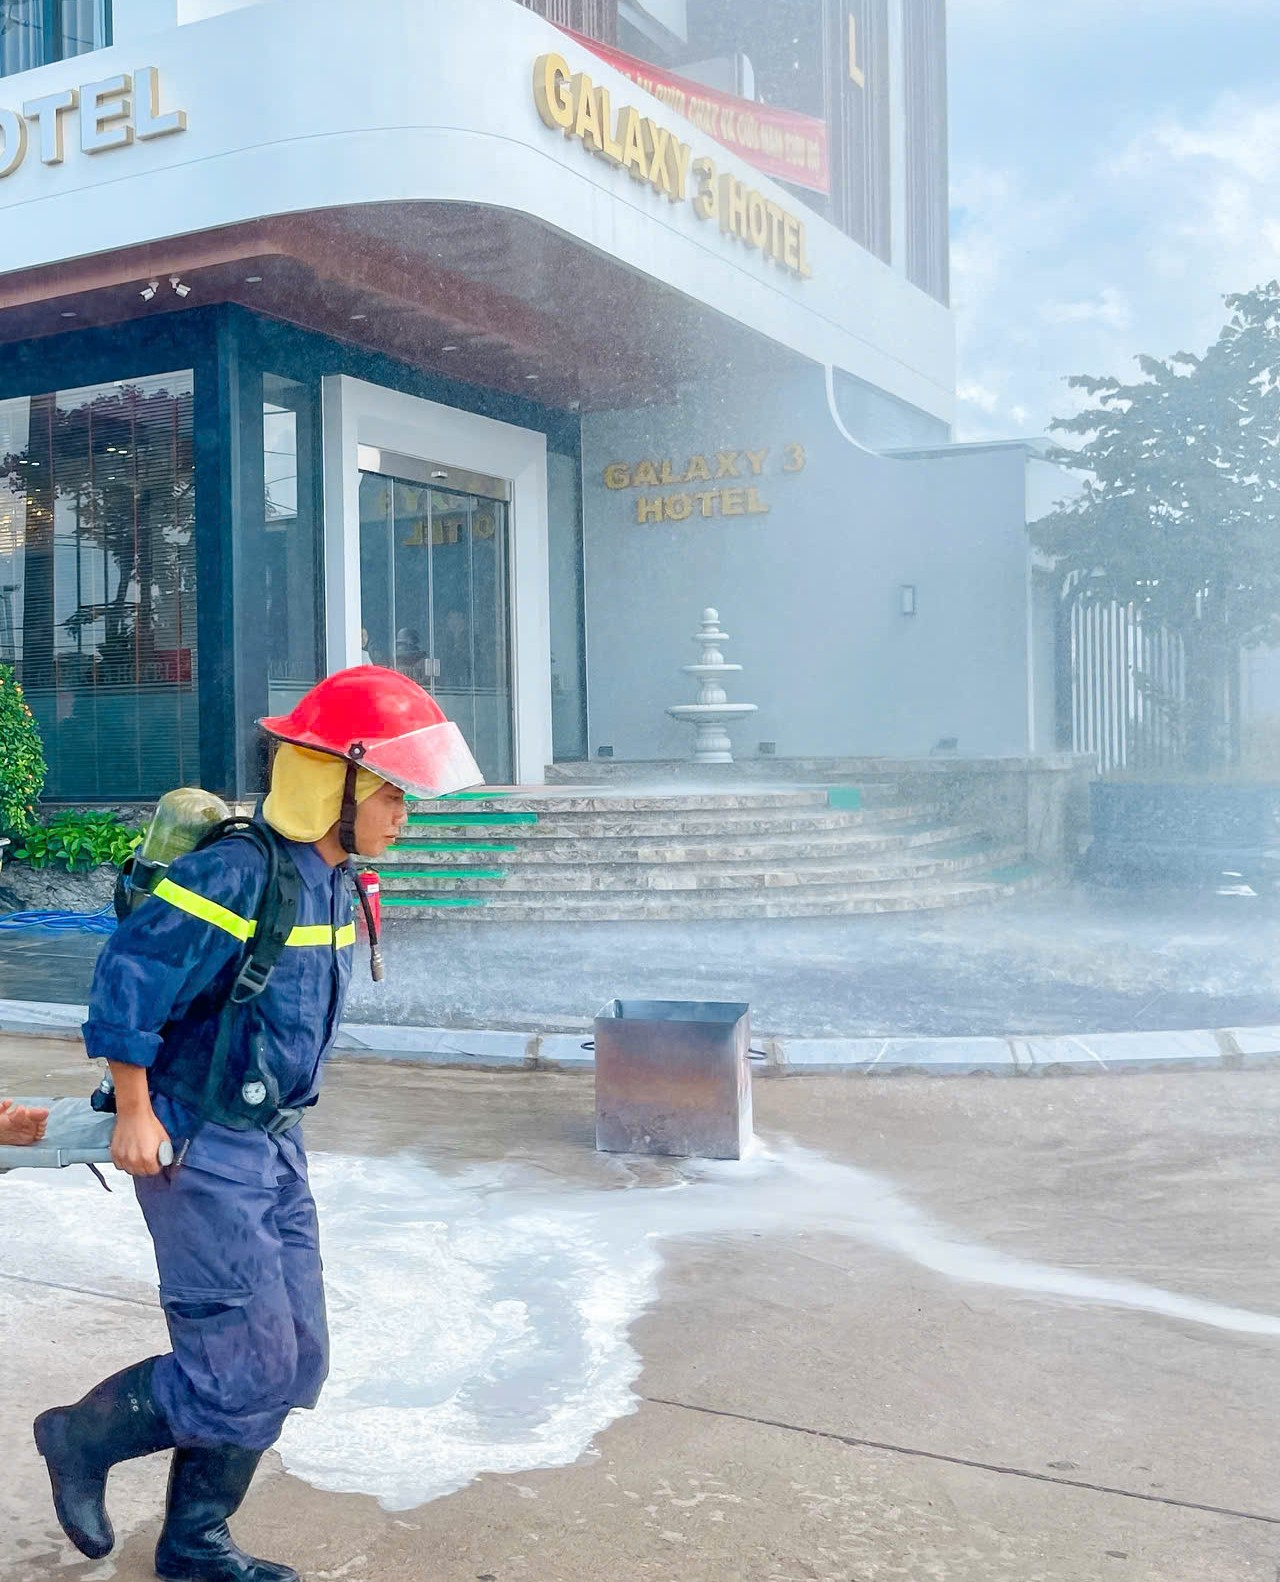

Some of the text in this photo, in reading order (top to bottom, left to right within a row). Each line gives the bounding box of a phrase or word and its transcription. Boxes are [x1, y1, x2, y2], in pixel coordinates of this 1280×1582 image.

[533, 52, 691, 202] GALAXY
[692, 157, 717, 220] 3
[720, 173, 813, 279] HOTEL
[604, 442, 805, 490] GALAXY 3
[636, 486, 769, 524] HOTEL
